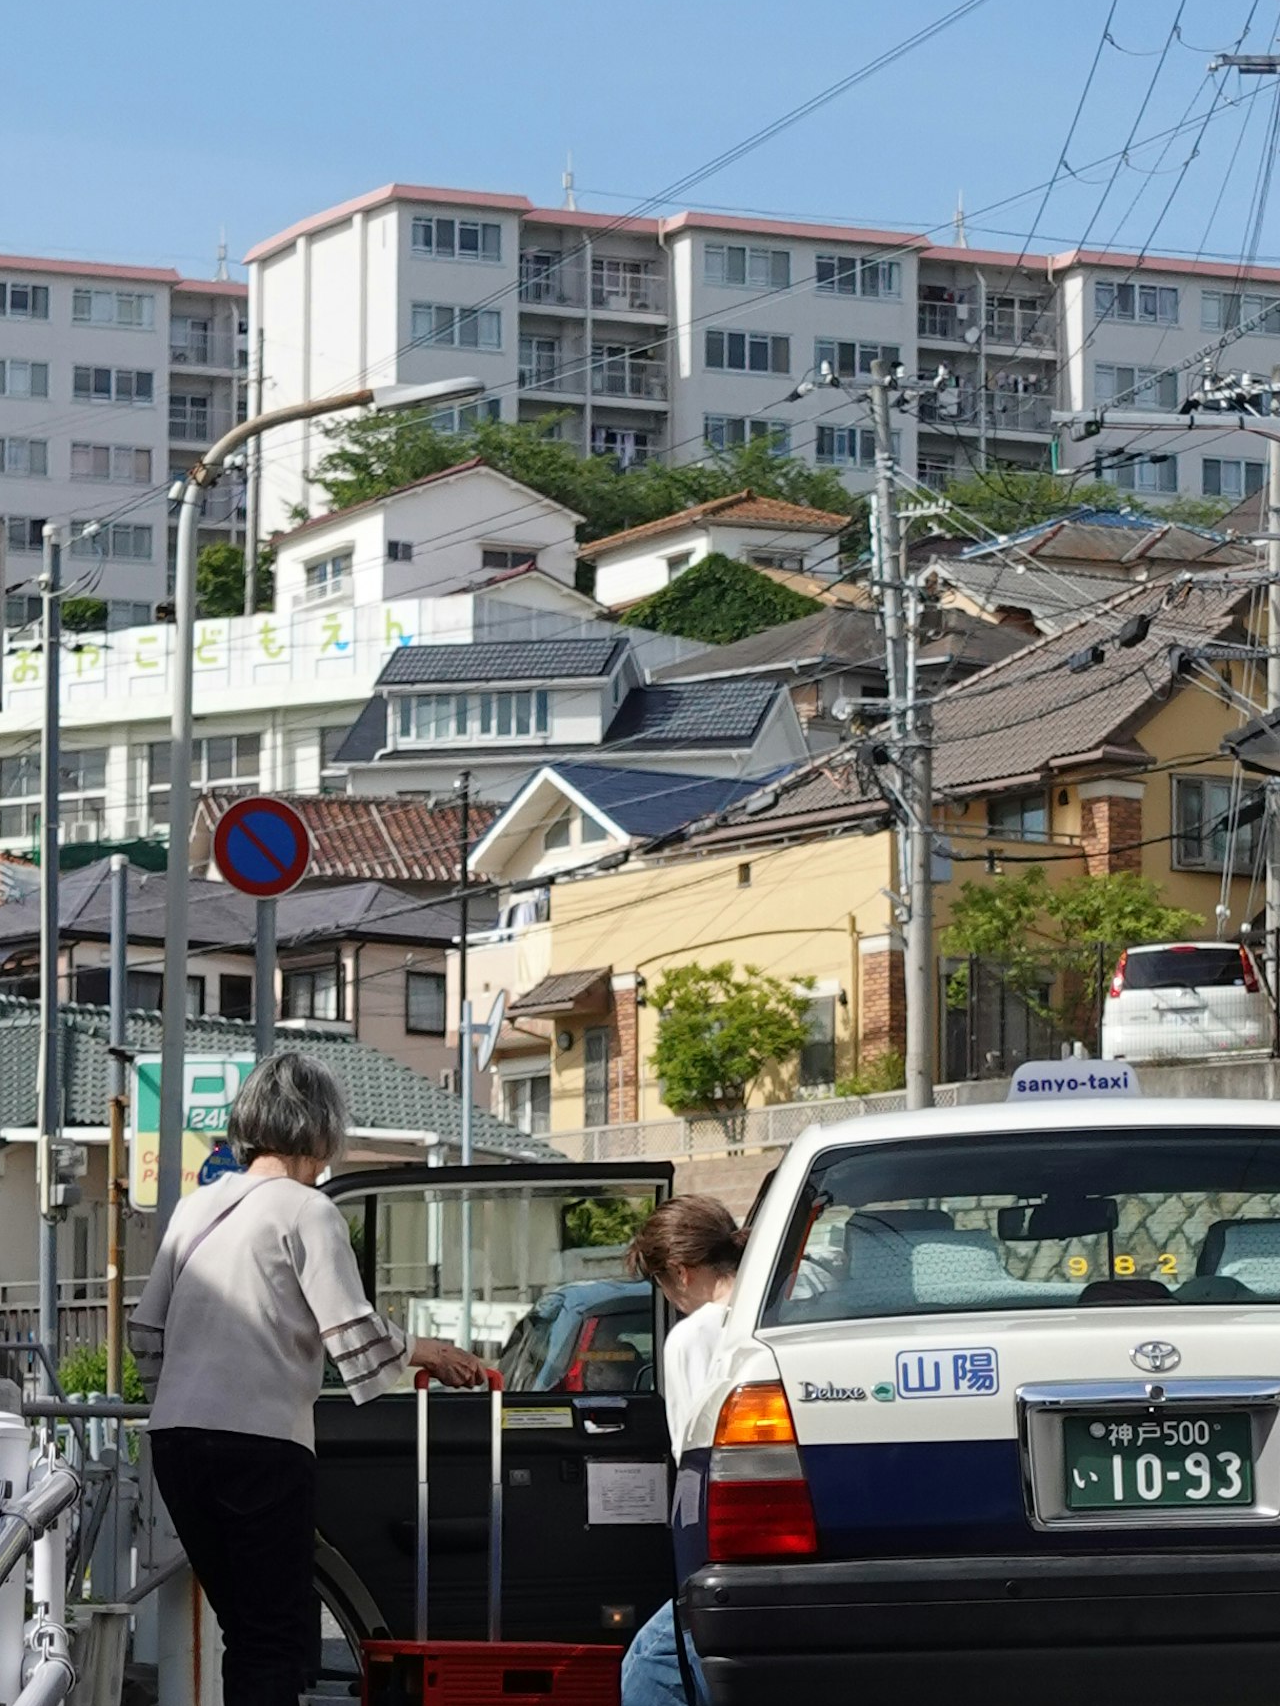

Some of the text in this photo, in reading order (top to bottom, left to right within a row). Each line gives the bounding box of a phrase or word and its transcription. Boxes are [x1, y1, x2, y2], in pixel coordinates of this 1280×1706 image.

[1017, 1071, 1128, 1092] sanyo-taxi
[902, 1353, 995, 1392] 山陽
[797, 1381, 868, 1403] Deluxe
[1073, 1451, 1242, 1501] い 10-93
